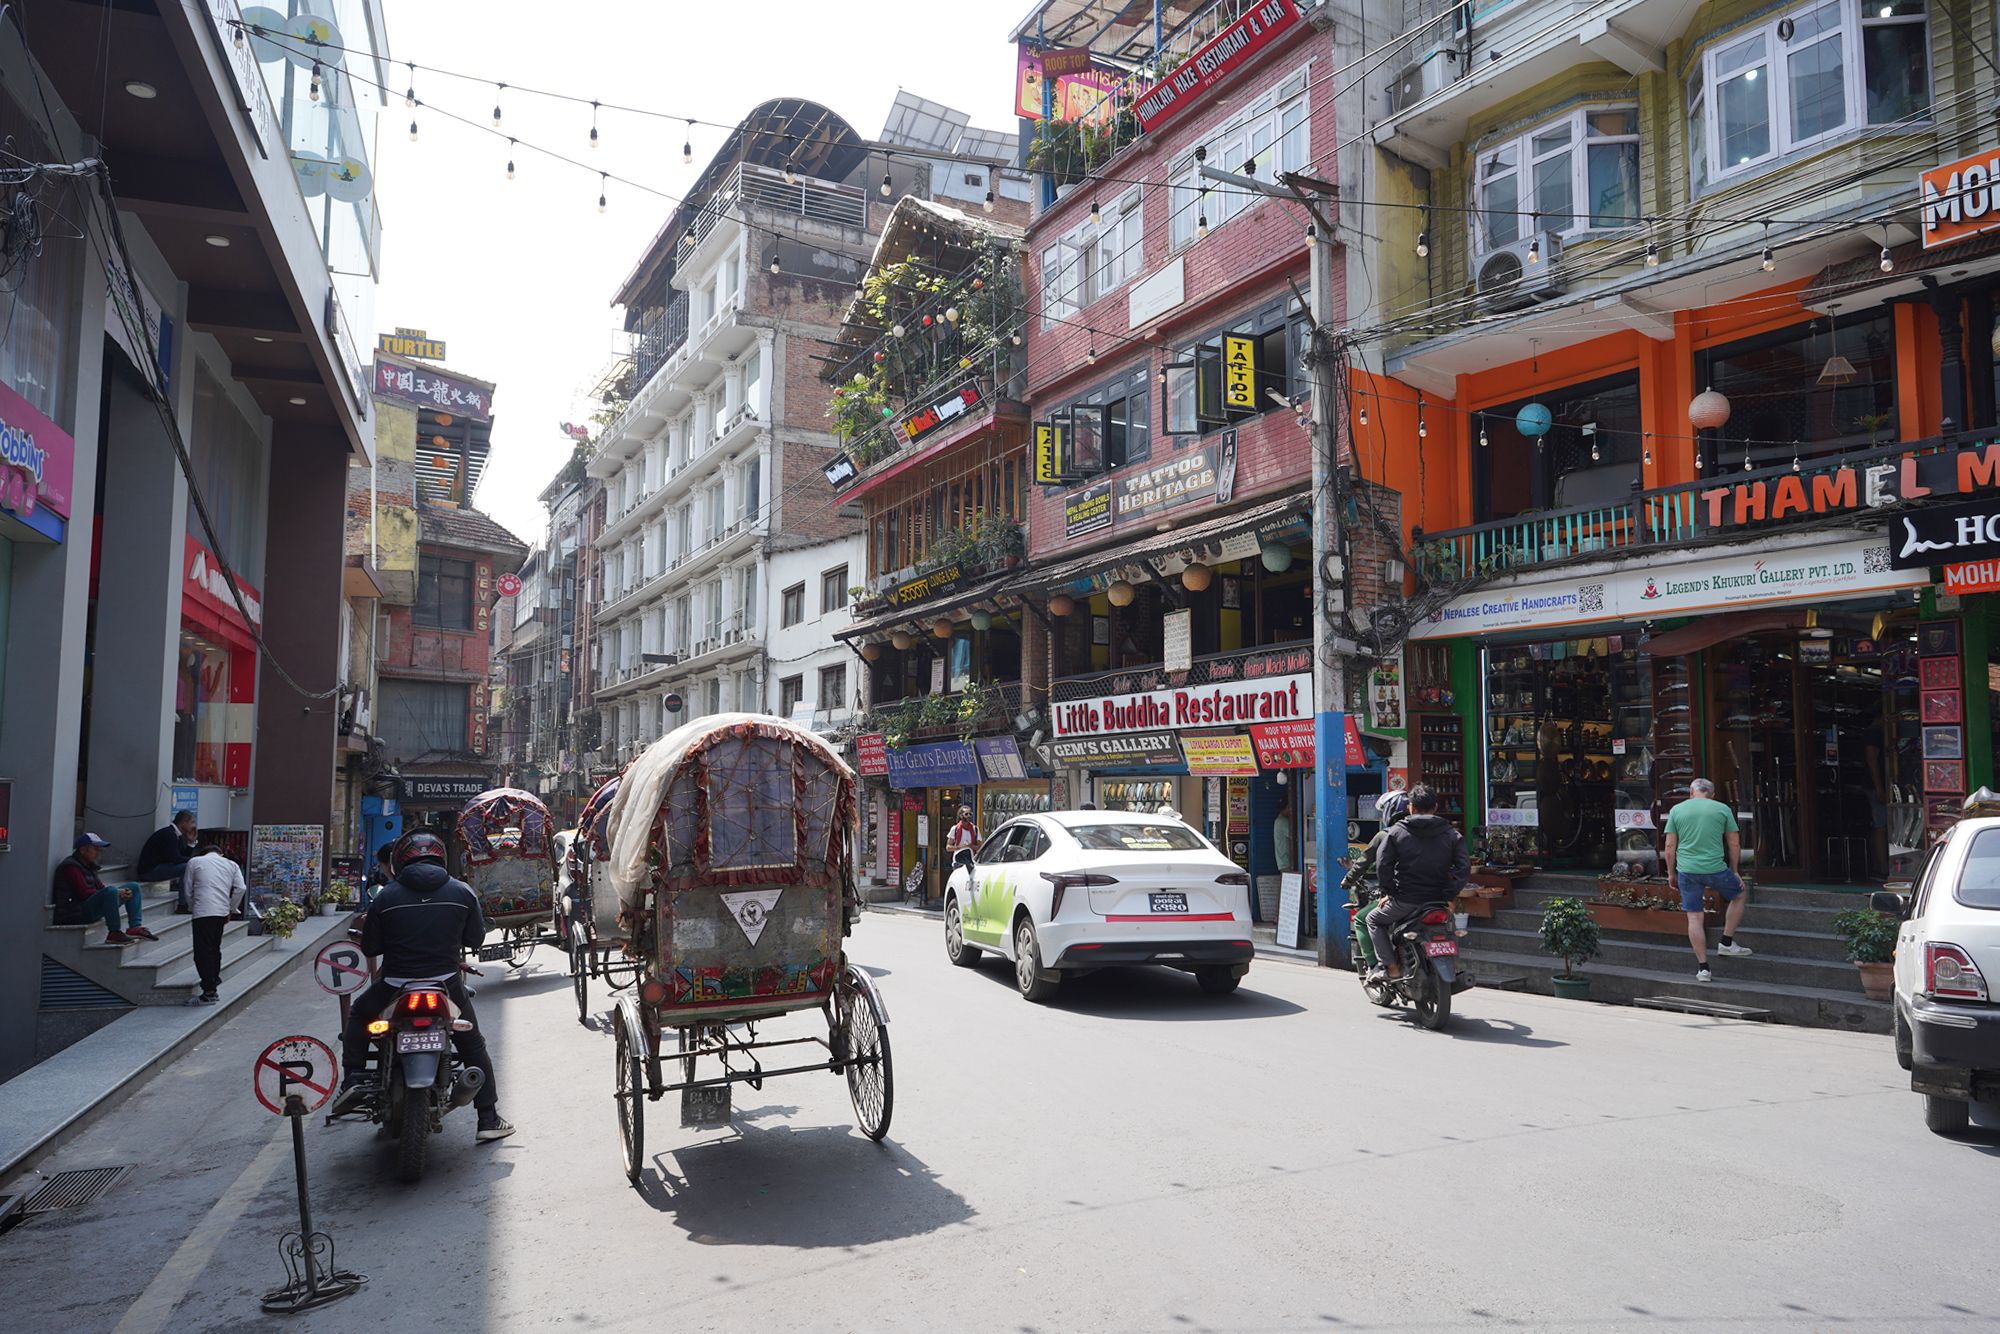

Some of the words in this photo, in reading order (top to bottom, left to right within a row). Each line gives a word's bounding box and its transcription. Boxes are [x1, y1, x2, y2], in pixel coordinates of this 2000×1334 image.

[1044, 57, 1069, 72] ROOF
[1070, 54, 1087, 68] TOP
[1137, 84, 1176, 123] HIMALAYA
[1173, 68, 1199, 93] HAZE
[1197, 24, 1251, 77] RESTAURANT
[1251, 19, 1262, 36] &
[1259, 0, 1286, 28] BAR
[395, 327, 427, 338] CLUB
[381, 336, 444, 359] TURTLE
[1232, 341, 1248, 402] TATTOO
[1126, 455, 1205, 492] TATTOO
[1220, 433, 1233, 500] TATTOO
[1118, 469, 1216, 515] HERITAGE
[1701, 458, 1931, 527] THAMEL
[899, 580, 931, 603] SCOOTY
[1666, 580, 1710, 596] LEGEND'S
[1712, 574, 1756, 590] KHUKURI
[1759, 567, 1805, 584] GALLERY
[1809, 565, 1831, 578] PVT.
[1833, 562, 1857, 576] LTD.
[1443, 606, 1480, 621] NEPALESE
[1482, 601, 1519, 616] CREATIVE
[1521, 593, 1577, 611] HANDICRAFTS
[1265, 658, 1286, 674] Made
[1056, 701, 1099, 734] Little
[1103, 695, 1170, 730] Buddha
[1175, 680, 1299, 726] Restaurant
[1264, 726, 1279, 736] ROOF
[1280, 725, 1291, 734] TOP
[1292, 723, 1315, 733] HIMALA
[1053, 741, 1099, 757] GEM'S
[1100, 735, 1171, 754] GALLERY
[1258, 738, 1280, 750] NAAN
[1281, 737, 1288, 749] &
[887, 753, 905, 770] THE
[906, 751, 935, 769] GEM'S
[934, 748, 975, 766] EMPIRE
[417, 783, 450, 793] DEVA'S
[453, 783, 482, 793] TRADE
[279, 1060, 313, 1097] P
